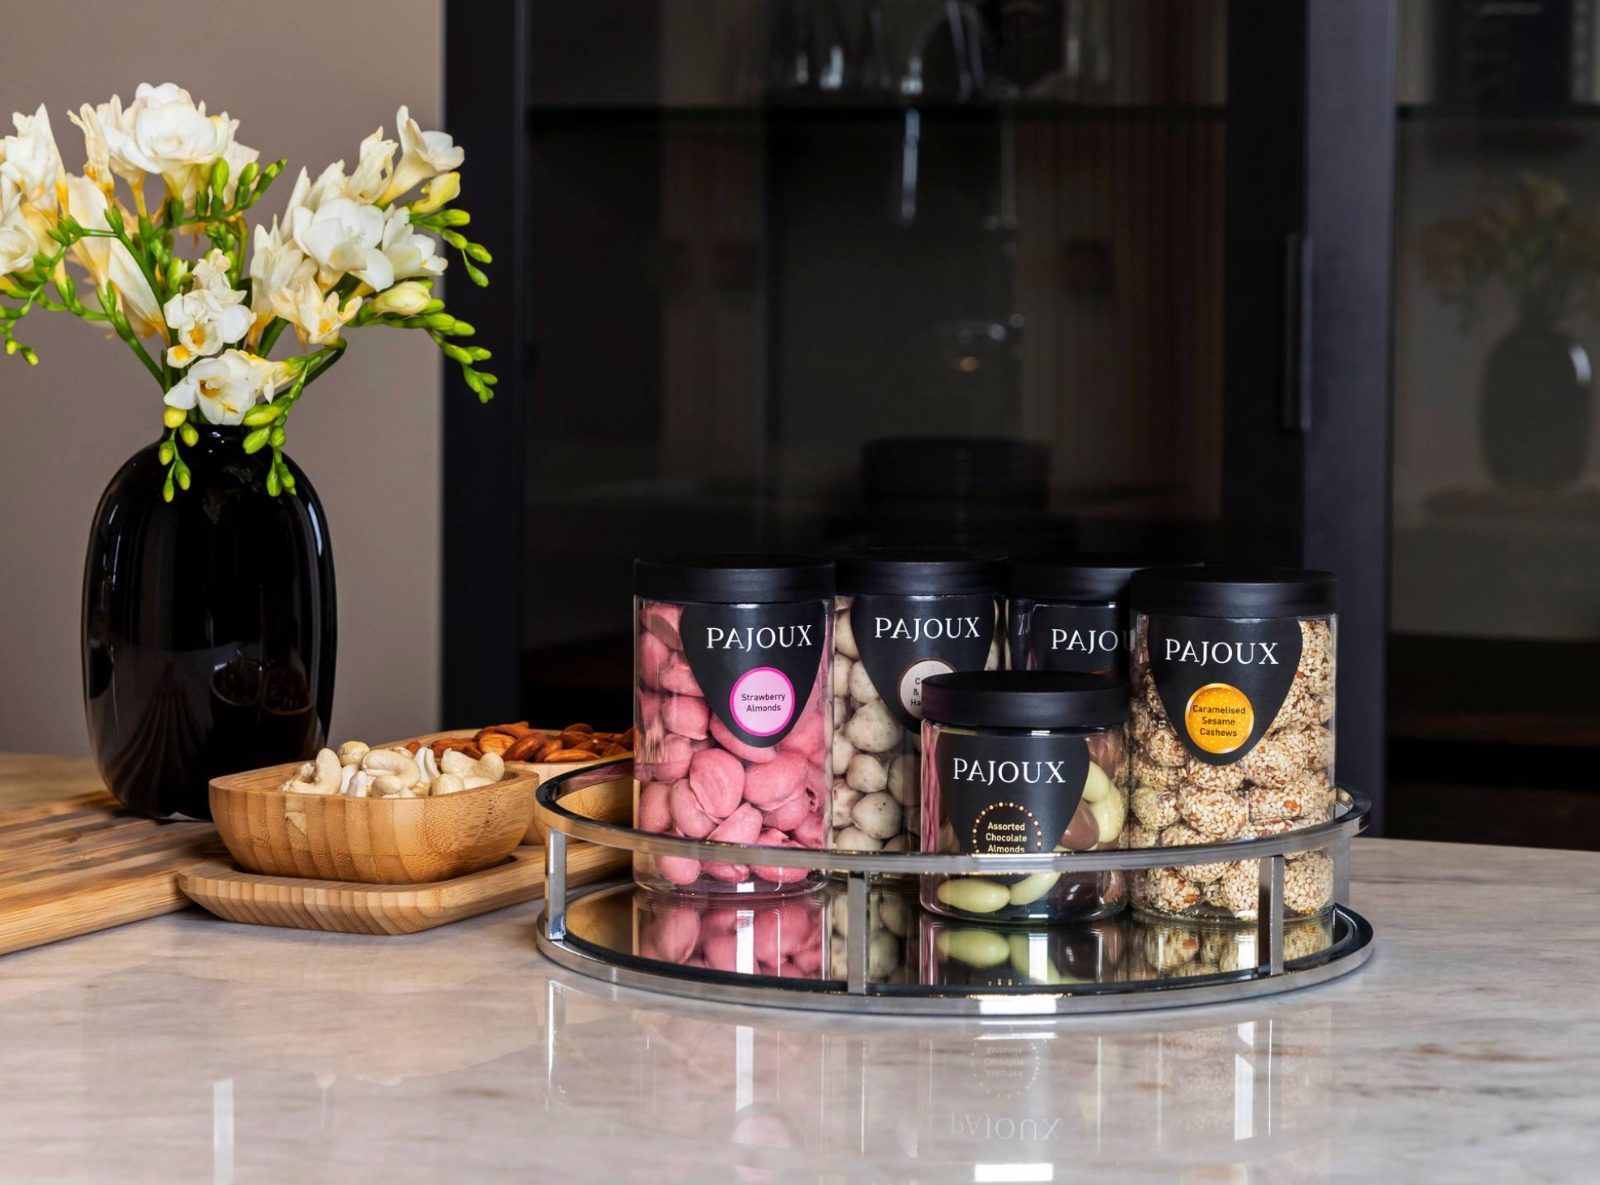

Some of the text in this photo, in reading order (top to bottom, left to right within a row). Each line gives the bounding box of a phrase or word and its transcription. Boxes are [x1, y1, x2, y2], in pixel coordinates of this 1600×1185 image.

[874, 616, 981, 643] PAJOUX
[706, 624, 812, 652] PAJOUX
[1165, 638, 1279, 667] PAJOUX
[741, 693, 785, 702] Strawberry
[746, 704, 781, 712] Almonds
[1192, 704, 1246, 715] Caramelised
[1202, 716, 1236, 726] Sesame
[1199, 727, 1238, 737] Cashews
[952, 757, 1067, 786] PAJOUX
[987, 821, 1026, 831] Assorted
[985, 832, 1028, 843] Chocolate
[987, 844, 1025, 853] Almonds
